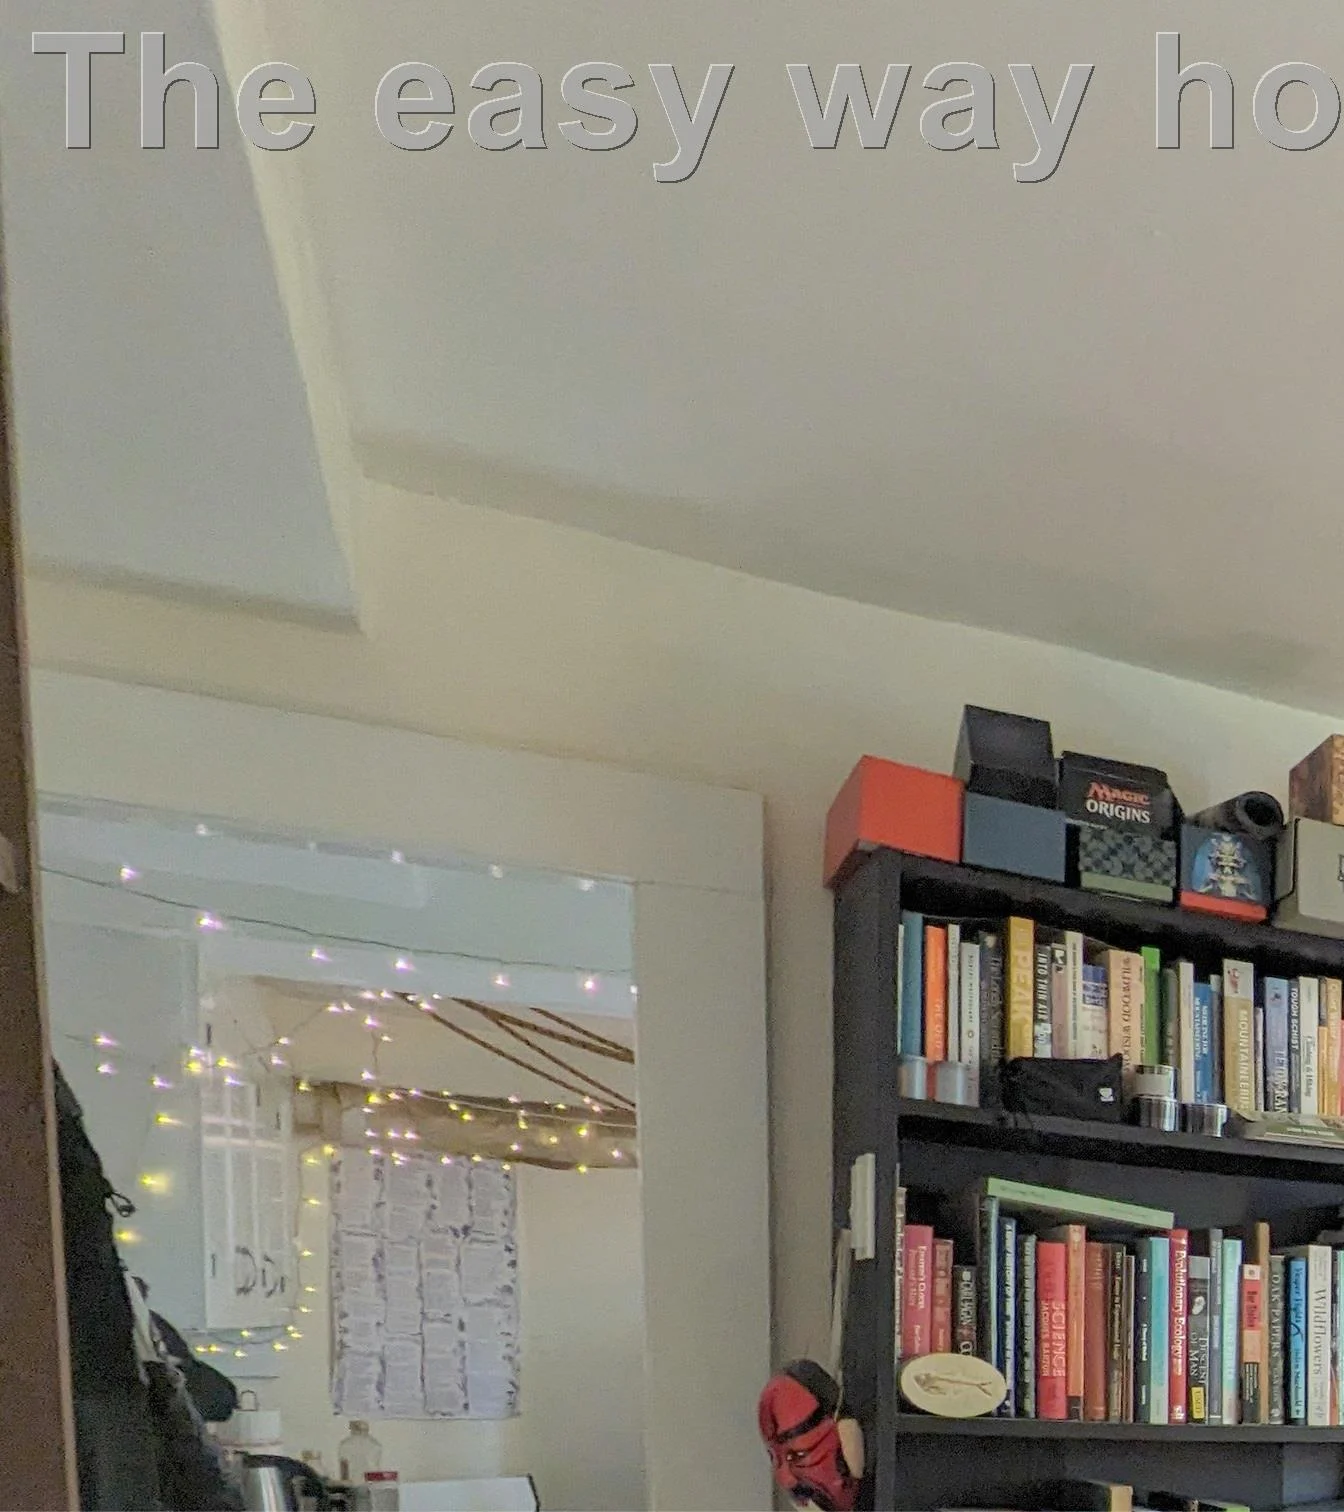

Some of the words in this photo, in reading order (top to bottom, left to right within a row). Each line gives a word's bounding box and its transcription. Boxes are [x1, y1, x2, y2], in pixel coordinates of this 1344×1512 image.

[1086, 799, 1151, 825] ORIGINS
[1036, 978, 1050, 1000] THIN
[1290, 986, 1299, 1016] TOUGH
[1037, 1002, 1050, 1020] AIR
[1290, 1018, 1300, 1050] SCHIST
[1172, 1250, 1188, 1314] Evolutionary
[1271, 1274, 1280, 1302] OAK
[1052, 1301, 1065, 1376] SCIENCE
[1171, 1315, 1187, 1359] Ecology
[1313, 1289, 1328, 1375] Wildflowers
[1190, 1346, 1199, 1376] MAN
